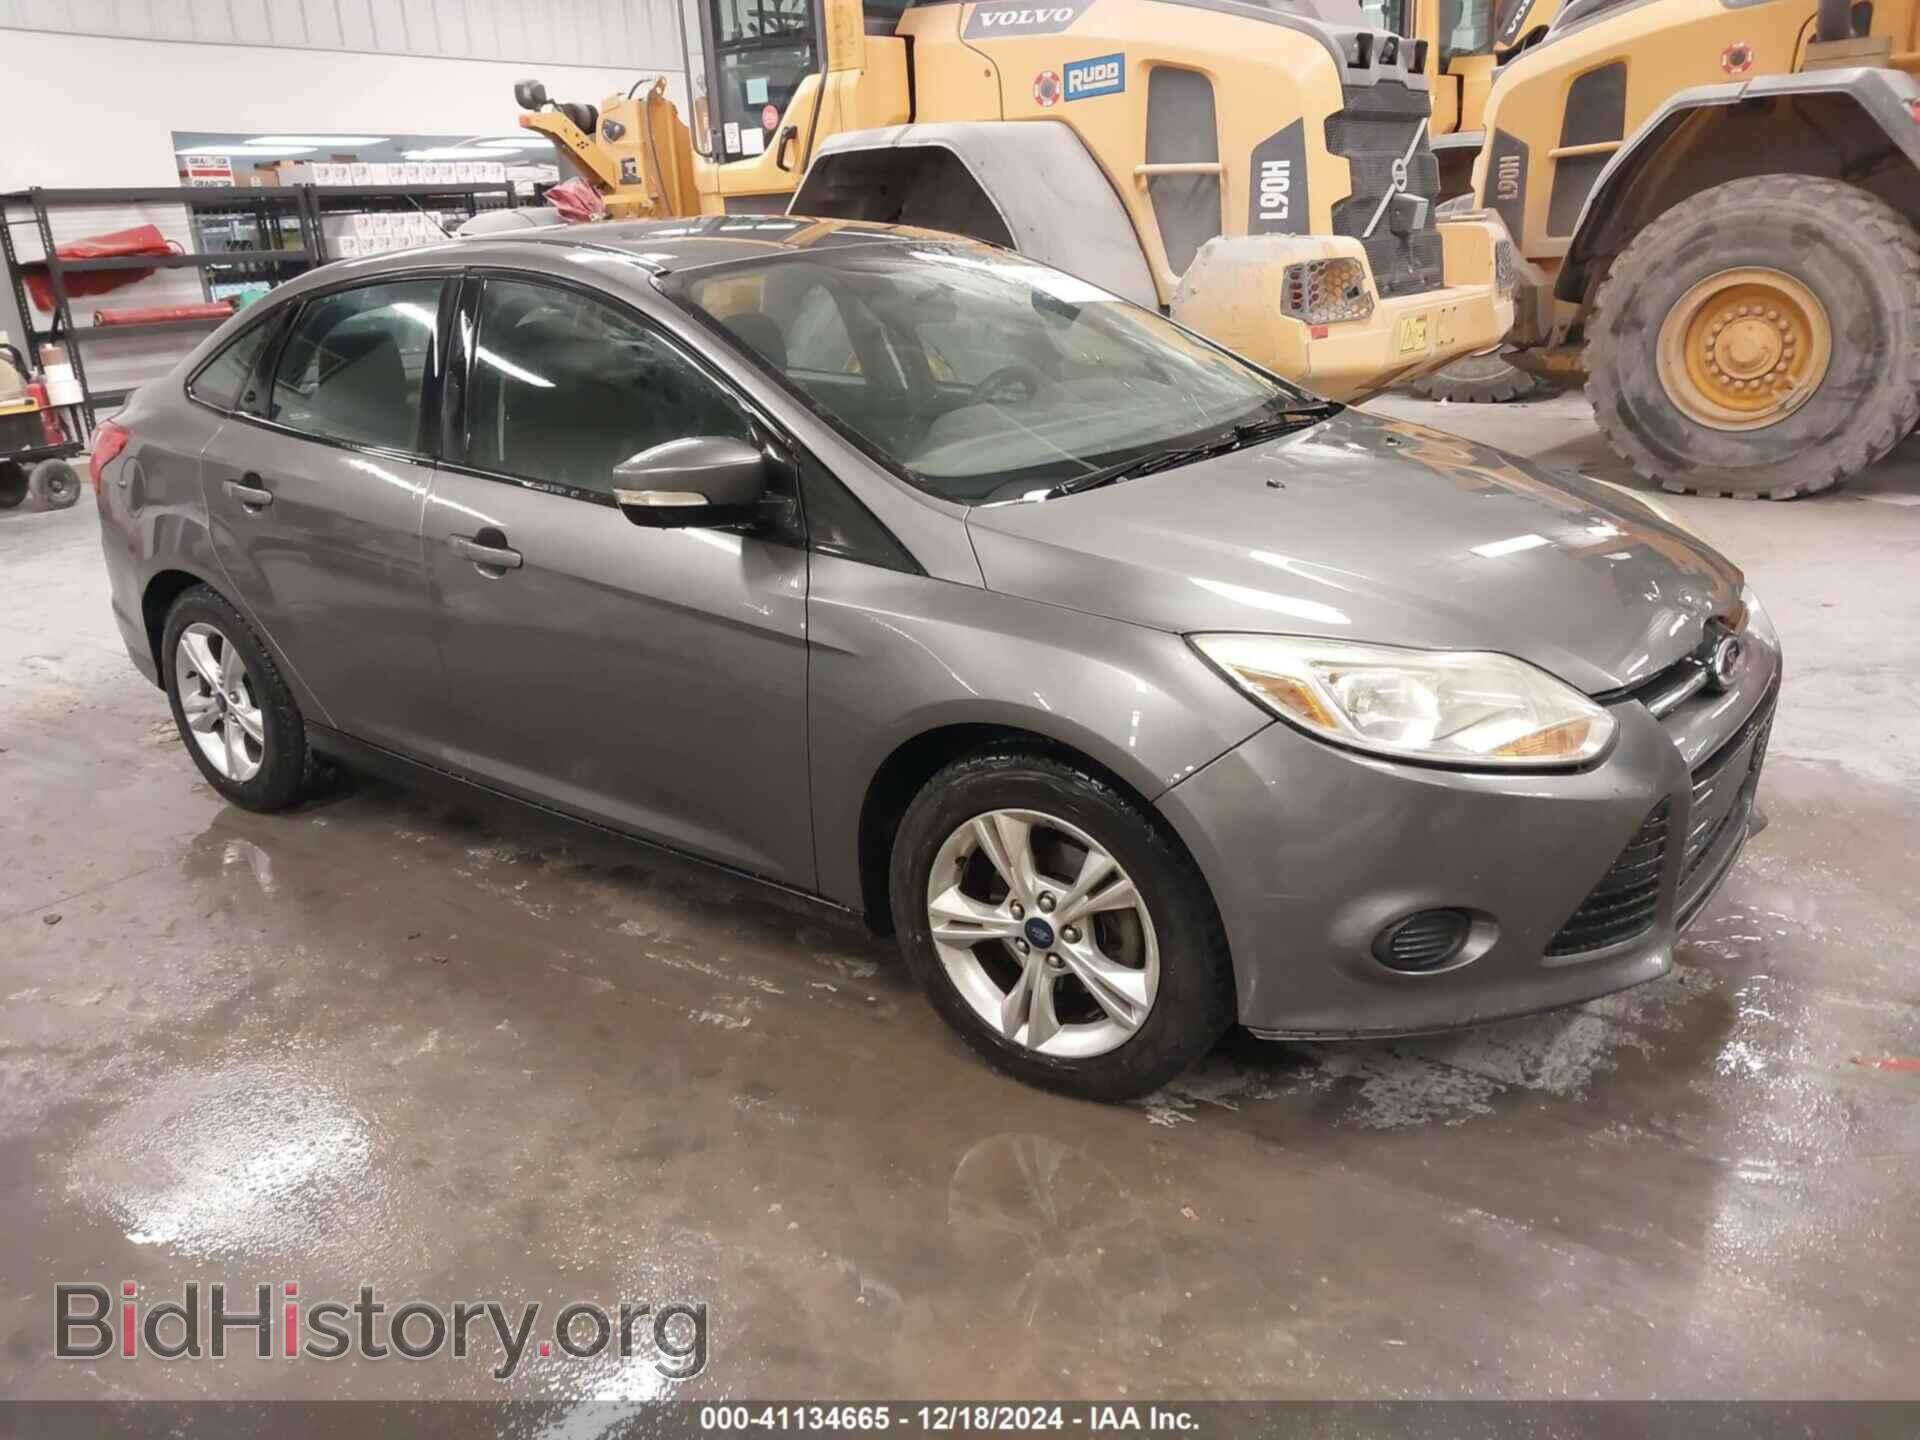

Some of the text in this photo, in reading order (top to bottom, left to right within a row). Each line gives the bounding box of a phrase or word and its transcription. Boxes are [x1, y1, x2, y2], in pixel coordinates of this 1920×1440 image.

[980, 7, 1074, 27] VOLVO
[1069, 62, 1119, 93] RUDD
[1260, 160, 1290, 220] L90H
[1498, 155, 1520, 200] L90H
